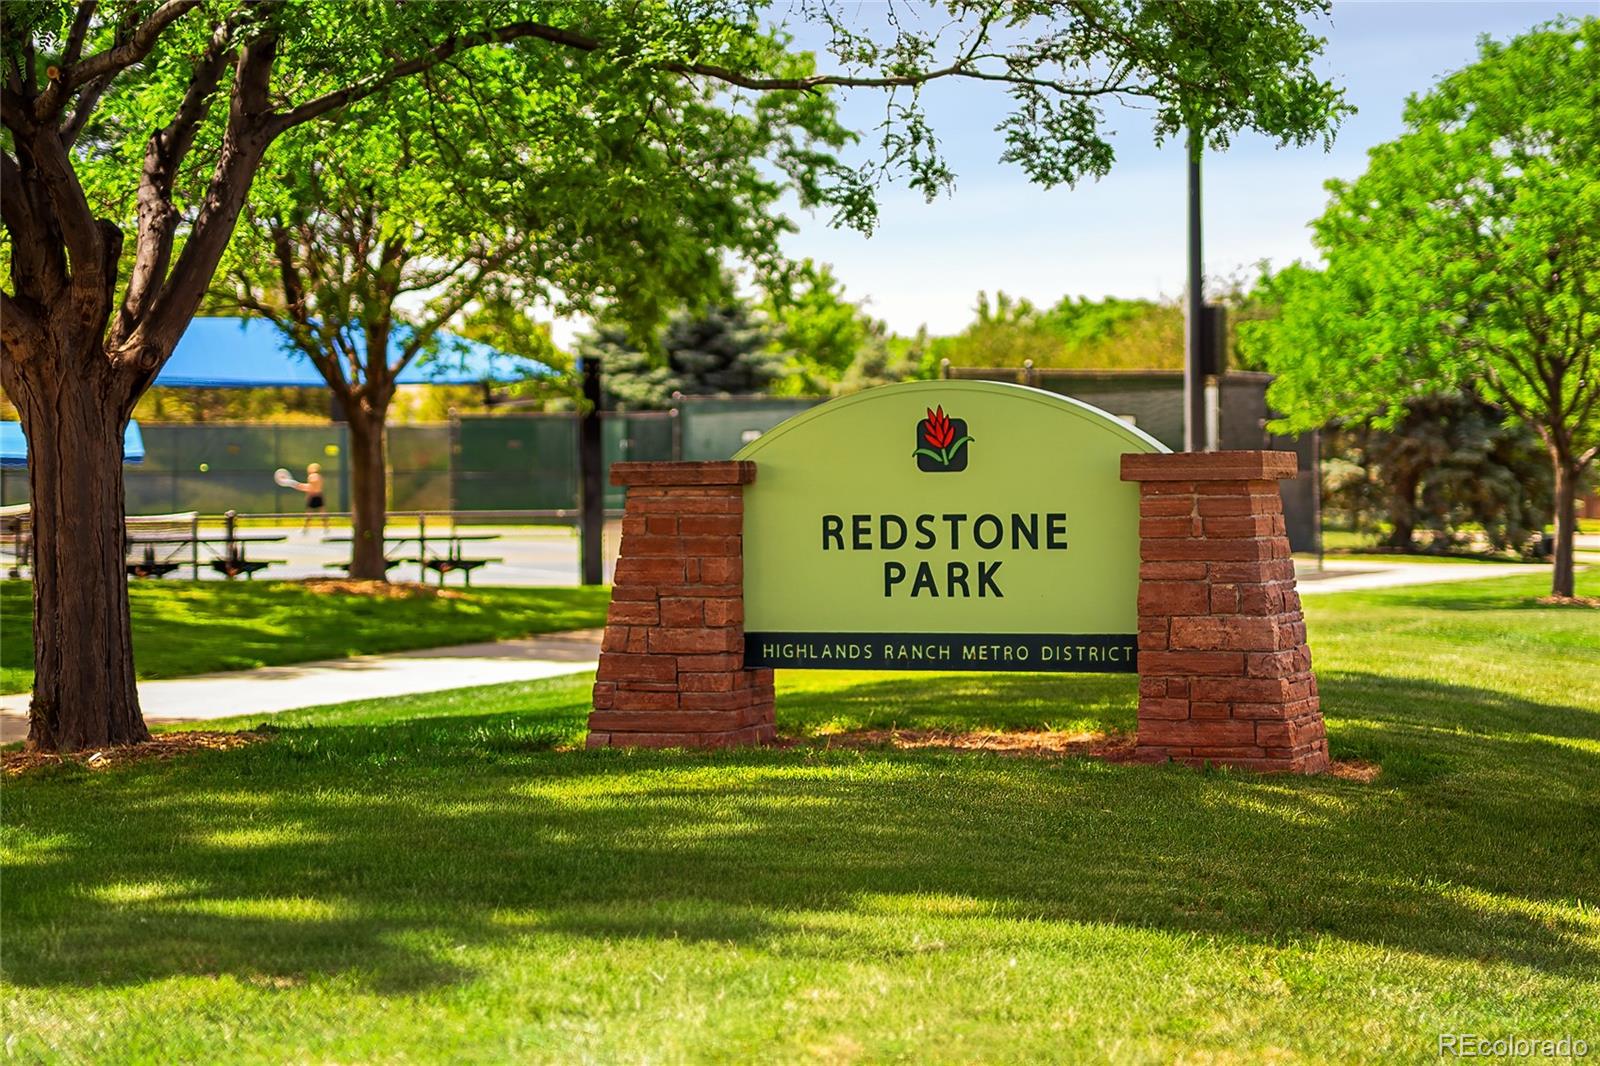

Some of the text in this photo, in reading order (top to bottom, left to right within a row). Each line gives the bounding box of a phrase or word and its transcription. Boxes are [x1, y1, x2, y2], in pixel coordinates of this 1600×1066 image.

[822, 513, 1068, 551] REDSTONE
[884, 561, 1004, 598] PARK
[763, 643, 1133, 663] HIGHLANDS RANCH METRO DISTRICT
